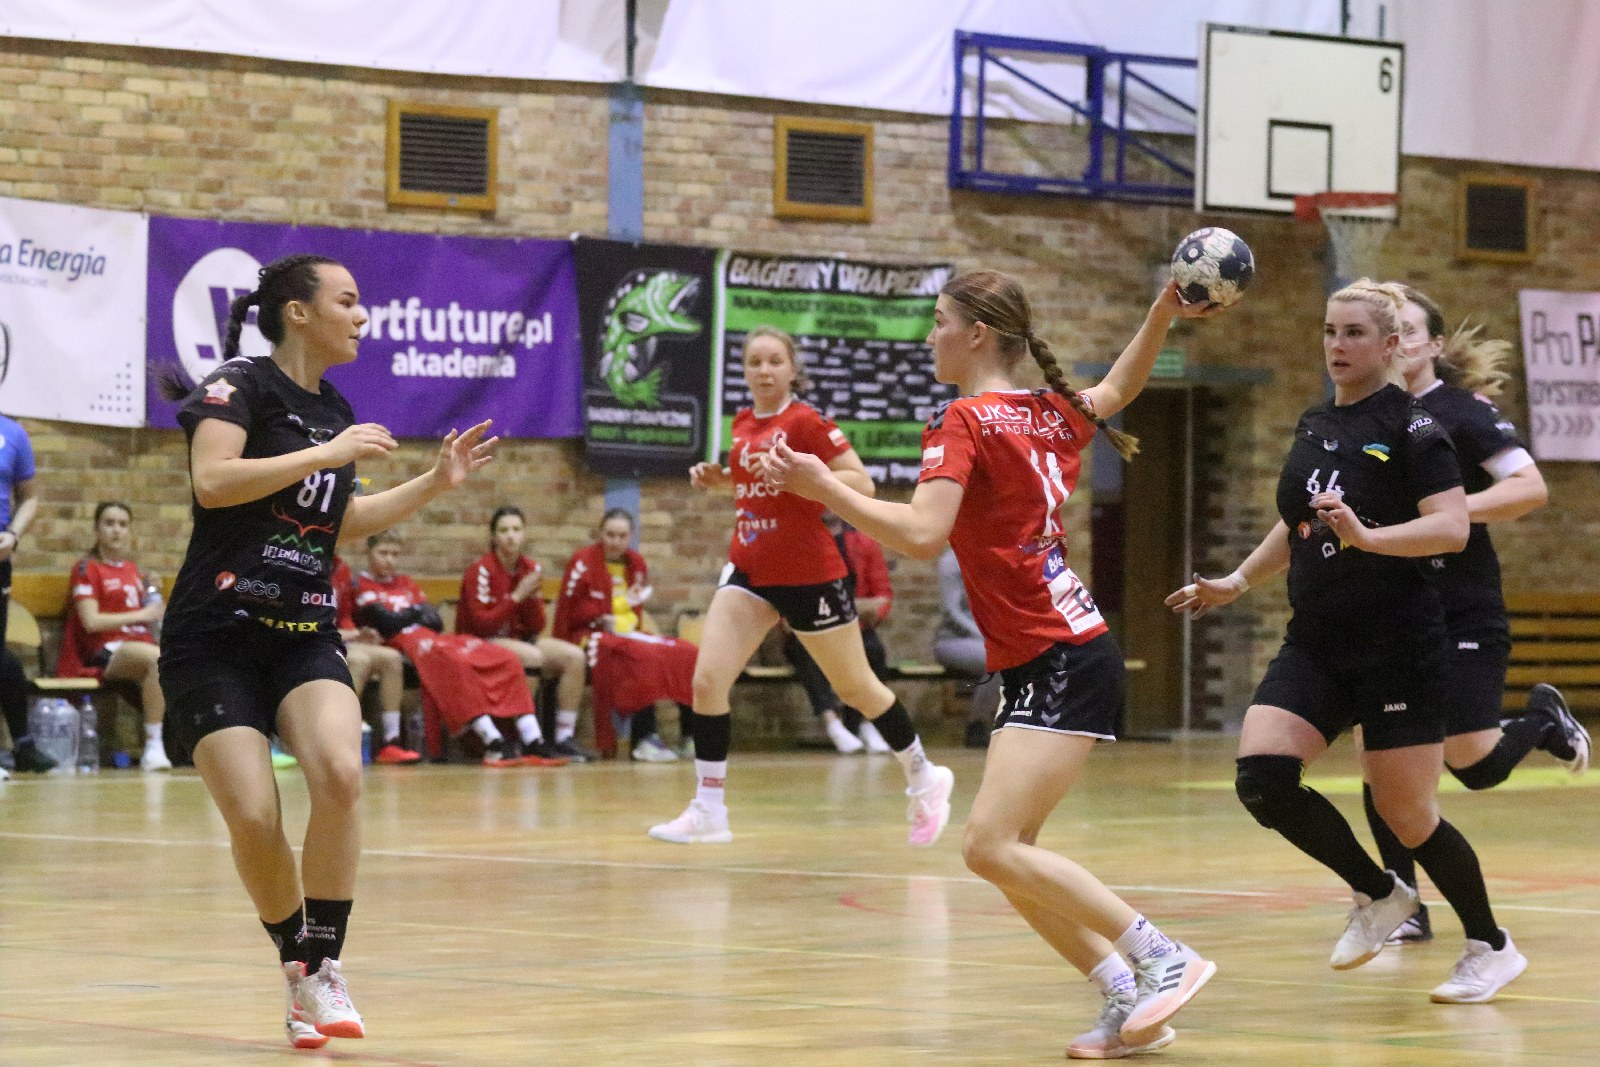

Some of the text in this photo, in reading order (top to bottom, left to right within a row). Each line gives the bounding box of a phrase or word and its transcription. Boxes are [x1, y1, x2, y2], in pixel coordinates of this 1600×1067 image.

[1379, 56, 1393, 94] 6
[18, 239, 106, 282] Energia
[1407, 417, 1433, 433] WILD
[297, 470, 336, 514] 81
[1383, 702, 1408, 712] JAKO
